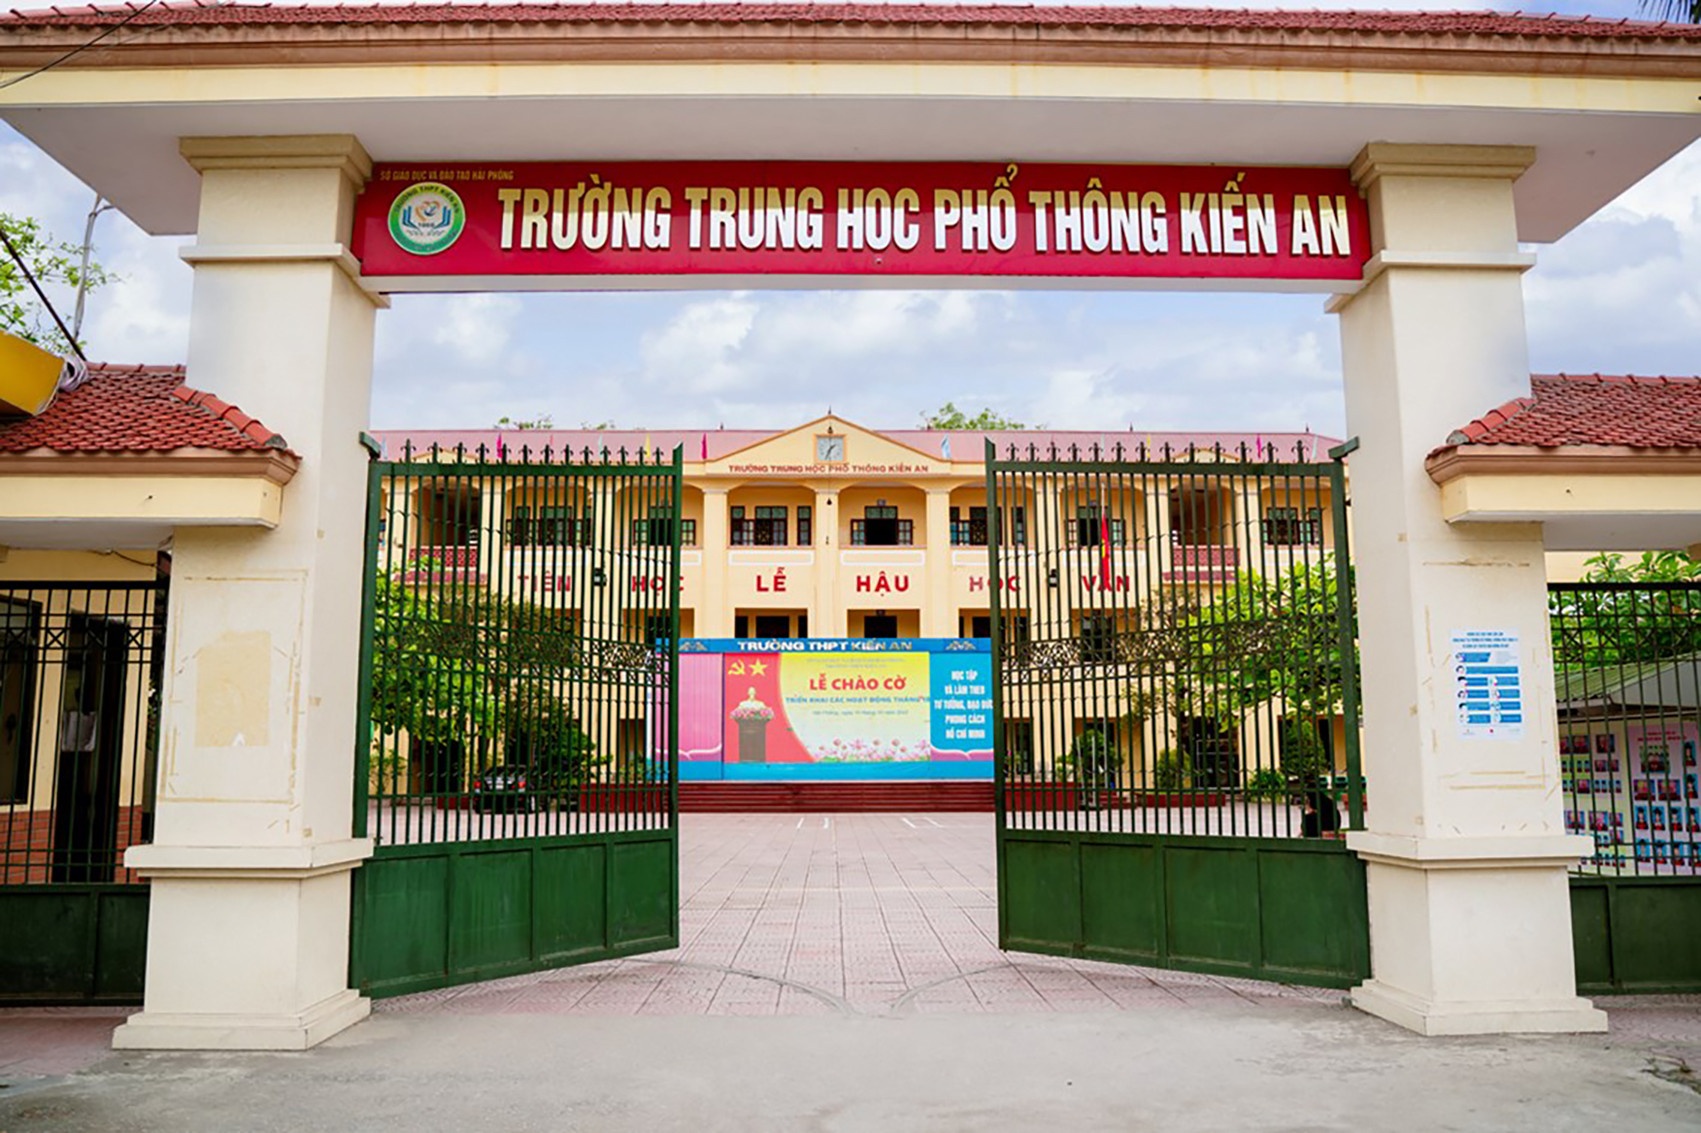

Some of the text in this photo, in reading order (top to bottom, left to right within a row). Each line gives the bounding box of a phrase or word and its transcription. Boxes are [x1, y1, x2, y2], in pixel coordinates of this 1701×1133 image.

[498, 174, 671, 250] TRƯỜNG
[685, 187, 823, 249] TRUNG
[934, 163, 1018, 251] PHỔ
[1029, 178, 1168, 253] THÔNG
[1180, 172, 1278, 254] KIẾN
[1292, 195, 1351, 255] AN
[852, 463, 886, 472] THÔNG
[757, 567, 786, 592] LỄ
[856, 571, 909, 596] HẬU
[737, 637, 912, 651] TRƯỜNG THPT KIẾN AN
[809, 673, 907, 690] LỄ CHÀO CỜ
